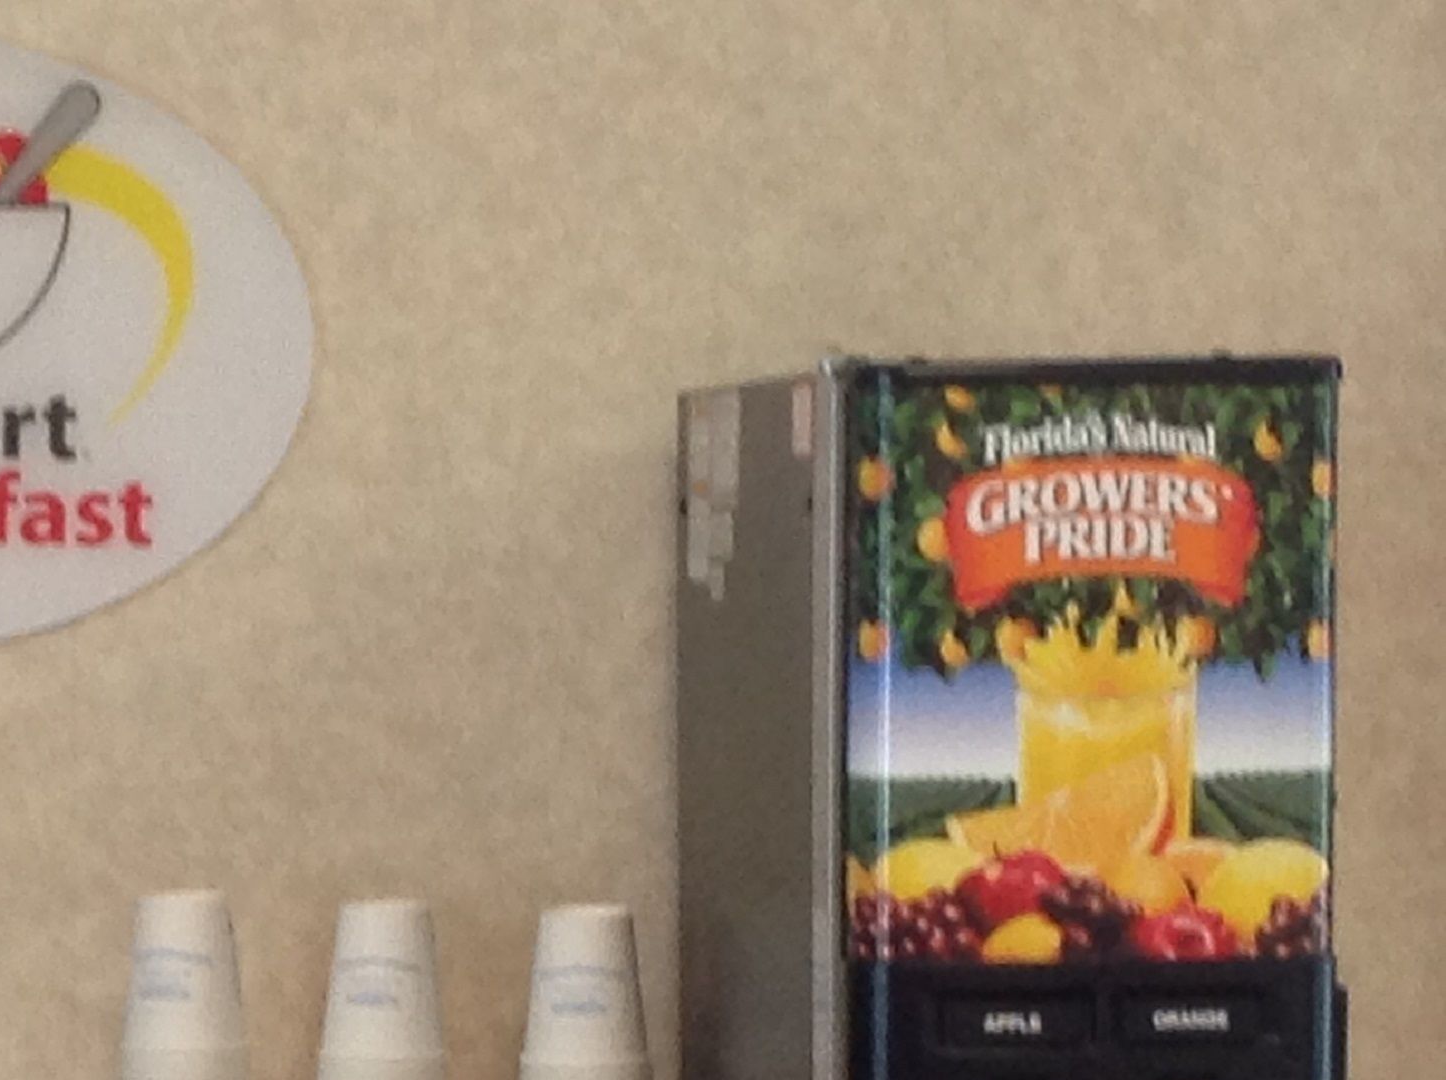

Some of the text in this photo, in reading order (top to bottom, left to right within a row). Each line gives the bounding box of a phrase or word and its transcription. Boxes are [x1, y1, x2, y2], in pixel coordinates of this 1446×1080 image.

[980, 411, 1217, 464] Florida's Natural
[1023, 515, 1176, 563] PRIDE
[984, 1011, 1042, 1034] APPLE
[1152, 1008, 1230, 1031] ORANGE
